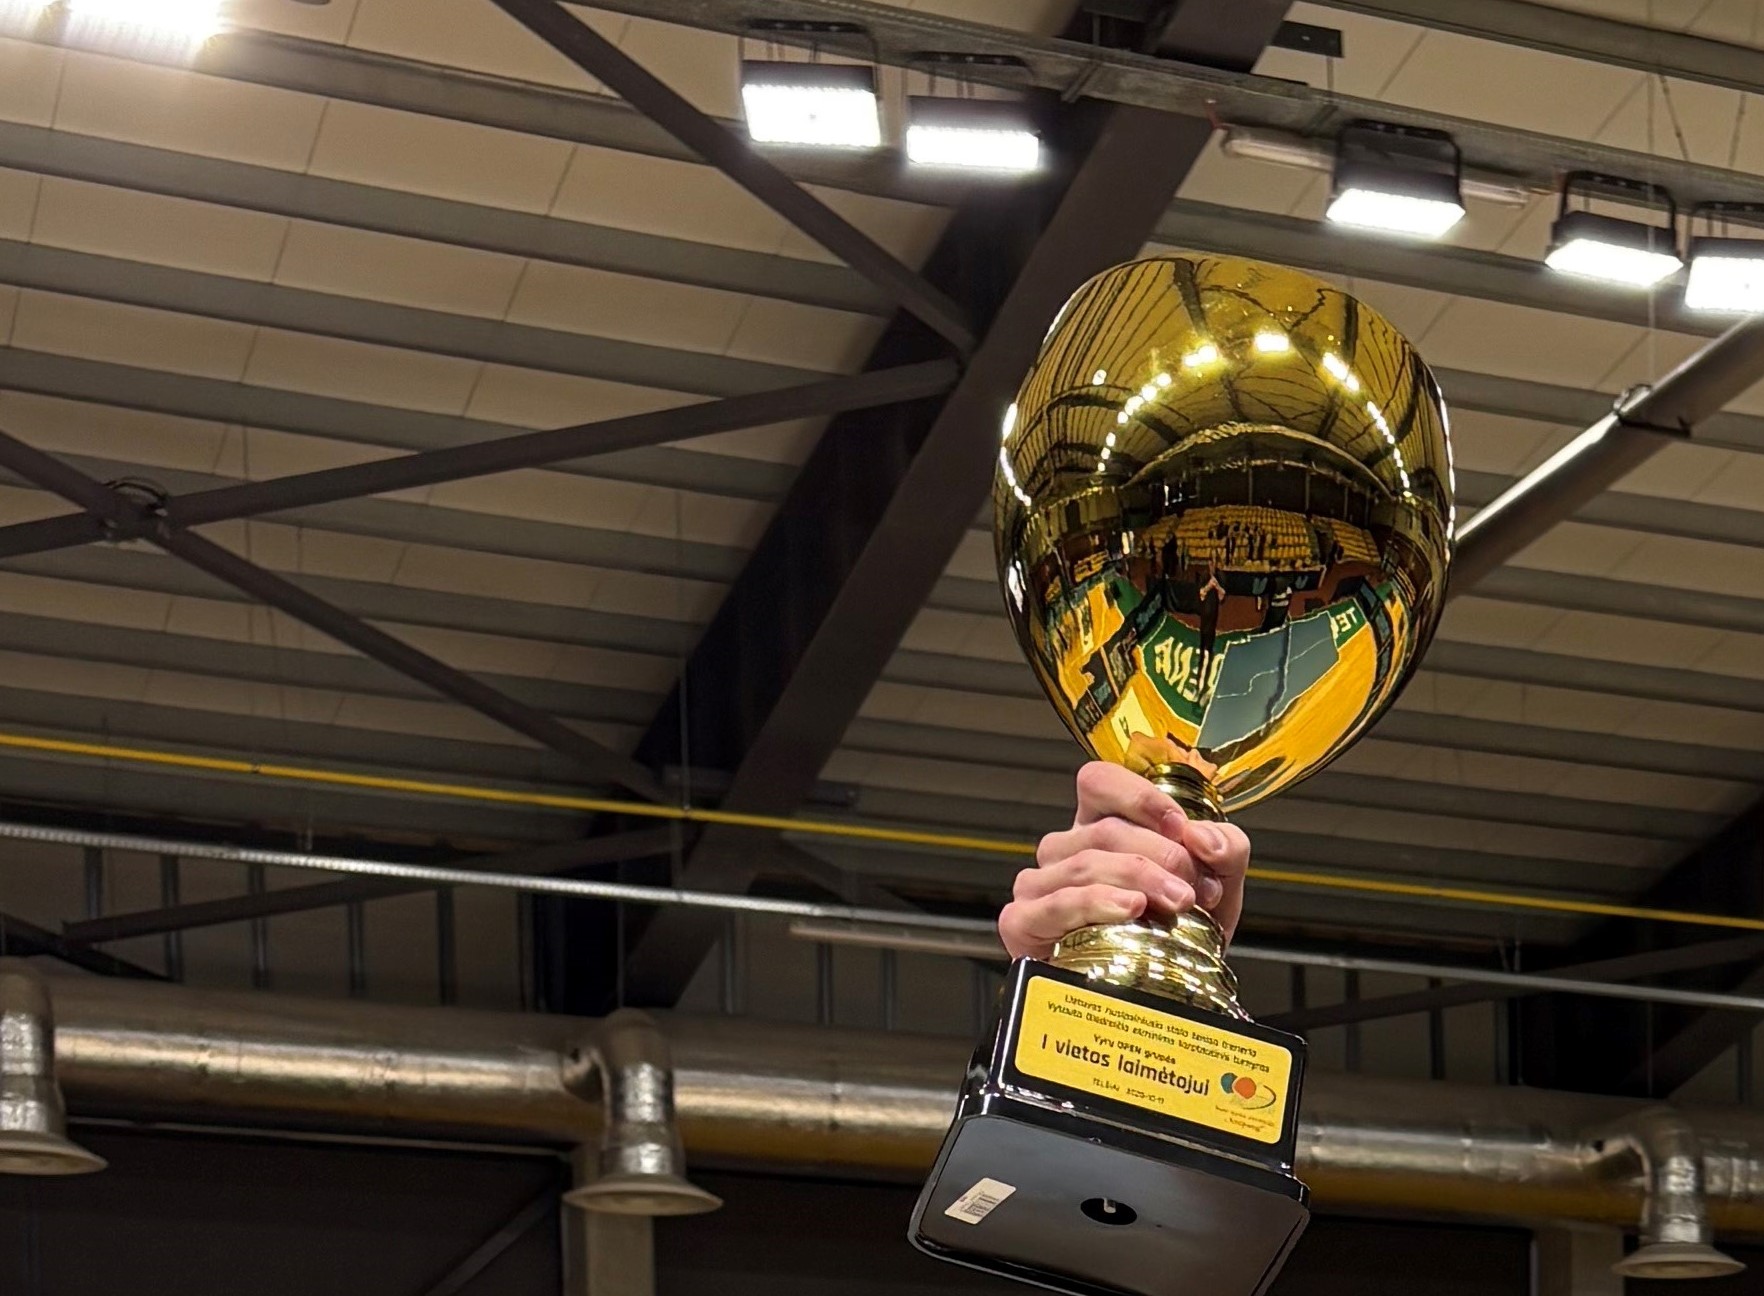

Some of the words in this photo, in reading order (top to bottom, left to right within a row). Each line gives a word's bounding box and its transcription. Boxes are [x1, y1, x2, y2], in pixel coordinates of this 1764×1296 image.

[1117, 1040, 1142, 1054] OPEN
[1055, 1039, 1110, 1067] vietos
[1118, 1053, 1210, 1096] laimėtojui
